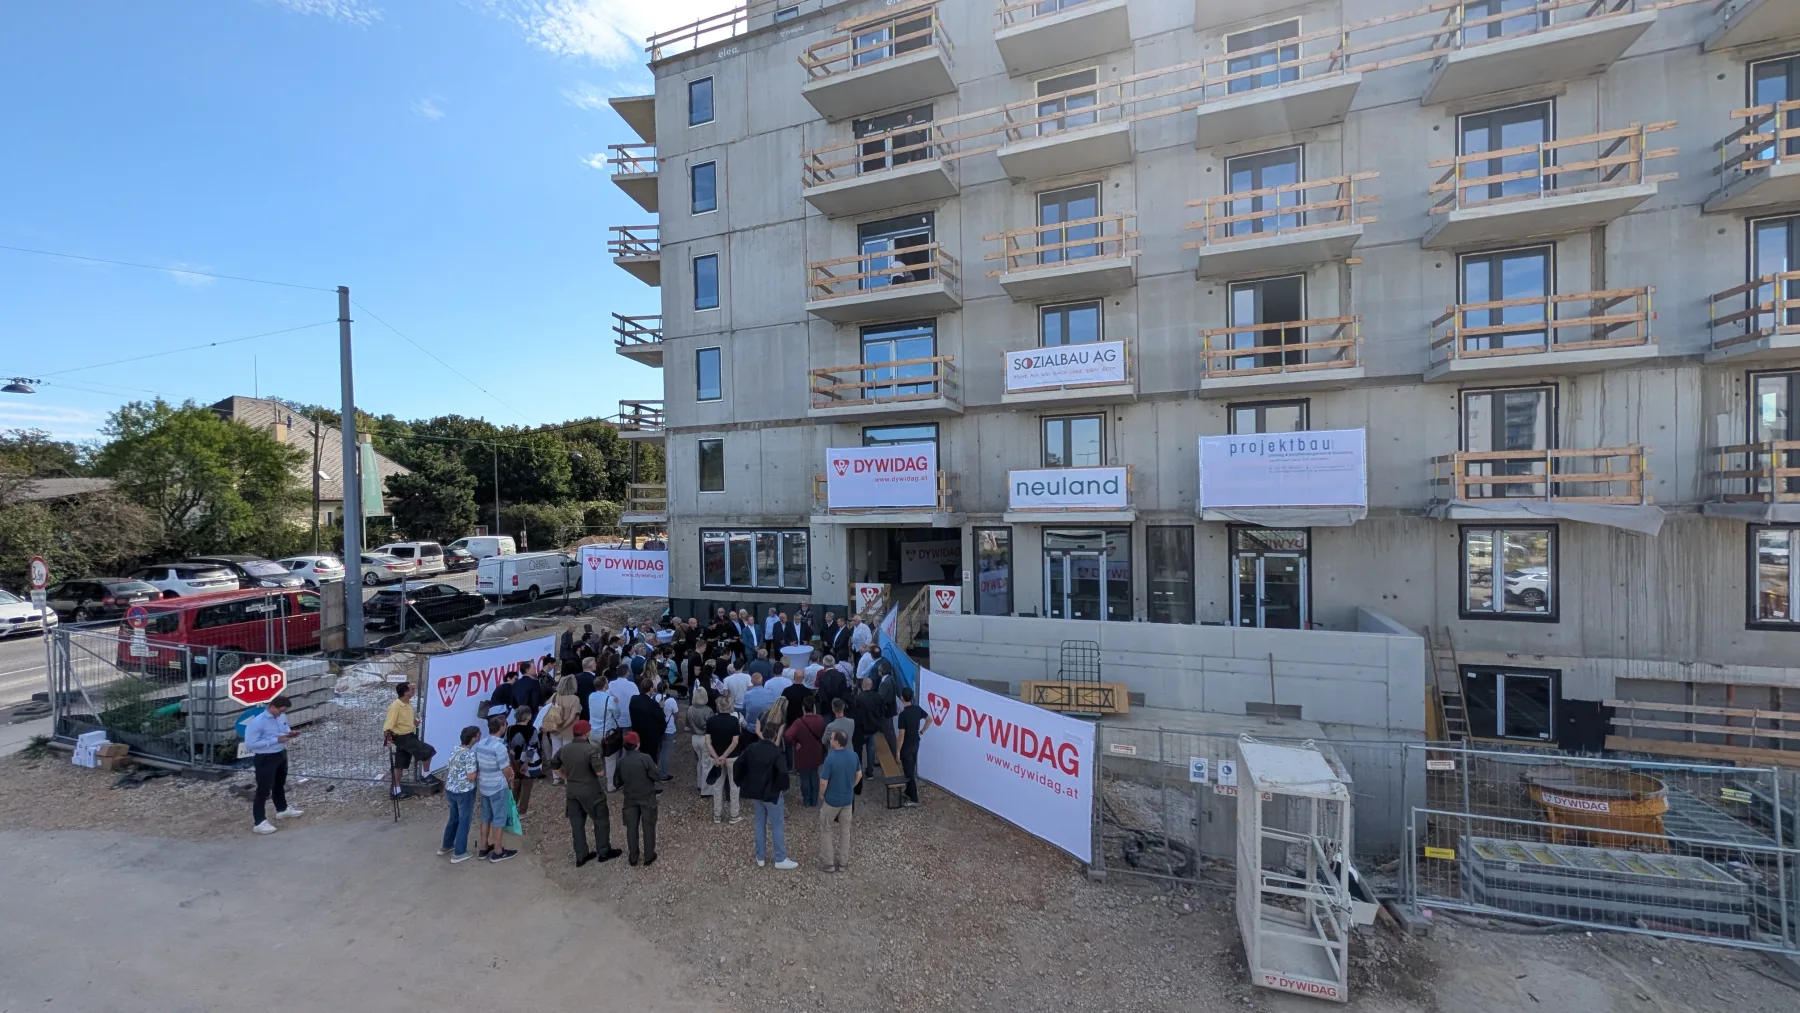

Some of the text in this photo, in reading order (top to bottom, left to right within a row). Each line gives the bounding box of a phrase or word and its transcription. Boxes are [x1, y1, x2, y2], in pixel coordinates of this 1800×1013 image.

[1014, 349, 1116, 371] SOZIALBAU AG
[1230, 438, 1330, 457] projektbau
[854, 456, 928, 474] DYWIDAG
[874, 475, 928, 484] www.dywidag.at
[1016, 475, 1119, 496] neuland
[605, 558, 664, 571] DYWIDAG
[233, 673, 282, 695] STOP
[956, 703, 1080, 778] DYWIDAG
[986, 752, 1079, 800] www.dywidag.at
[1554, 796, 1608, 811] DYWIDAG
[1280, 977, 1337, 997] DYWIDAG
